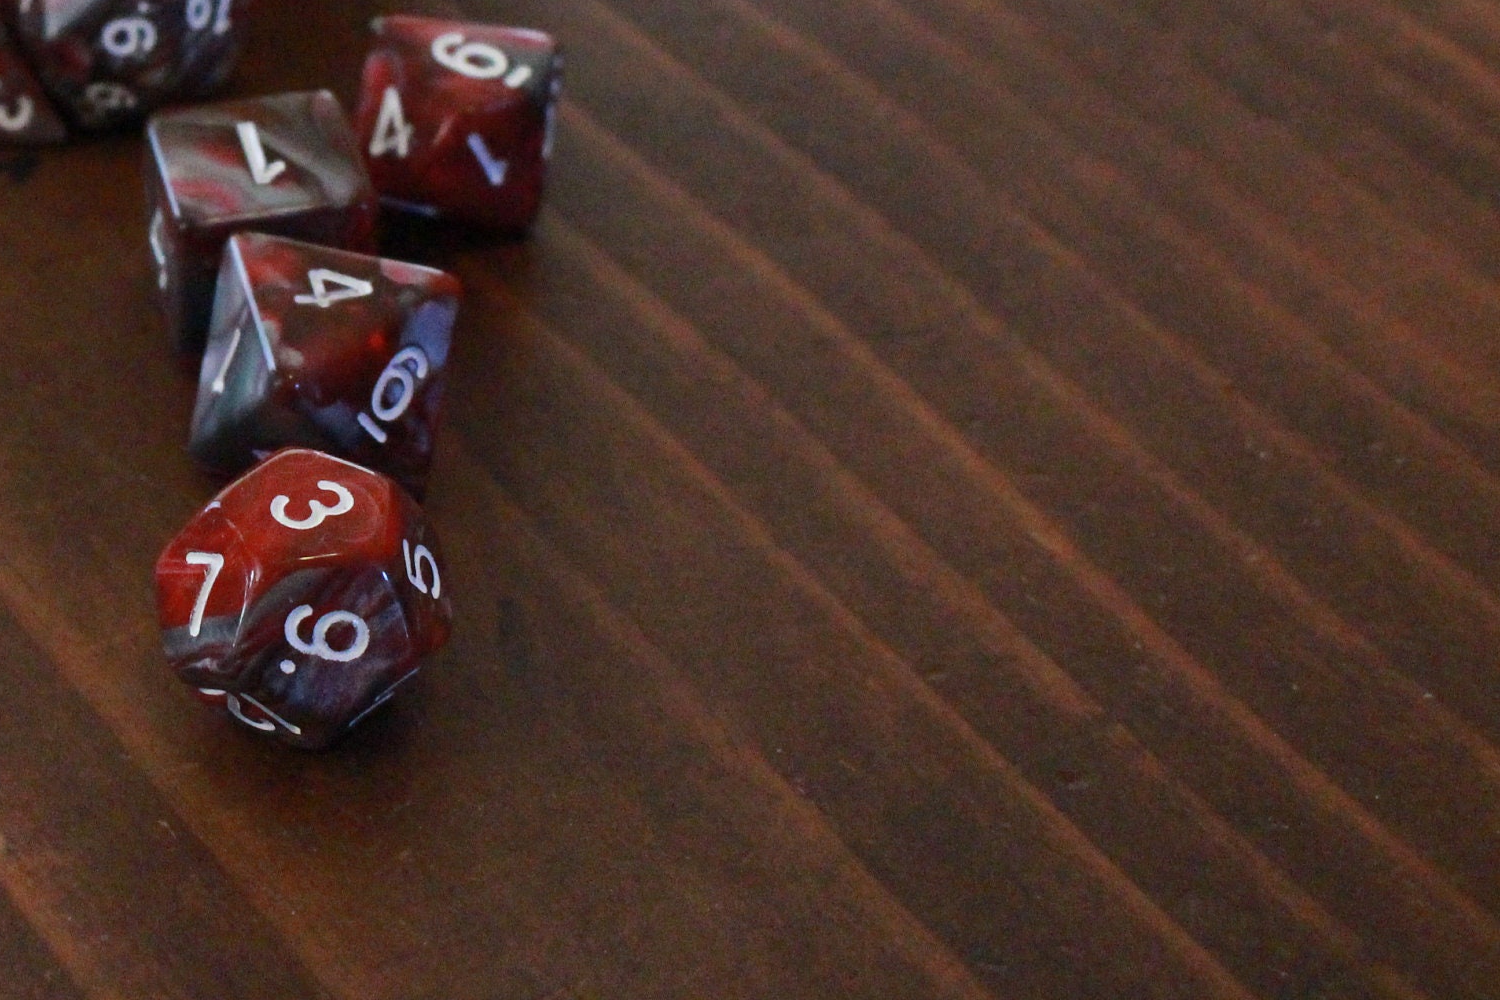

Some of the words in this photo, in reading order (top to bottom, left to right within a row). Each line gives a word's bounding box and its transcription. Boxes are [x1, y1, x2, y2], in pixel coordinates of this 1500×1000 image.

[370, 86, 413, 157] 4
[236, 121, 286, 185] 1
[467, 132, 508, 186] 1
[294, 268, 374, 308] 4
[269, 480, 355, 530] 3
[185, 551, 225, 638] 7
[402, 539, 441, 600] 5
